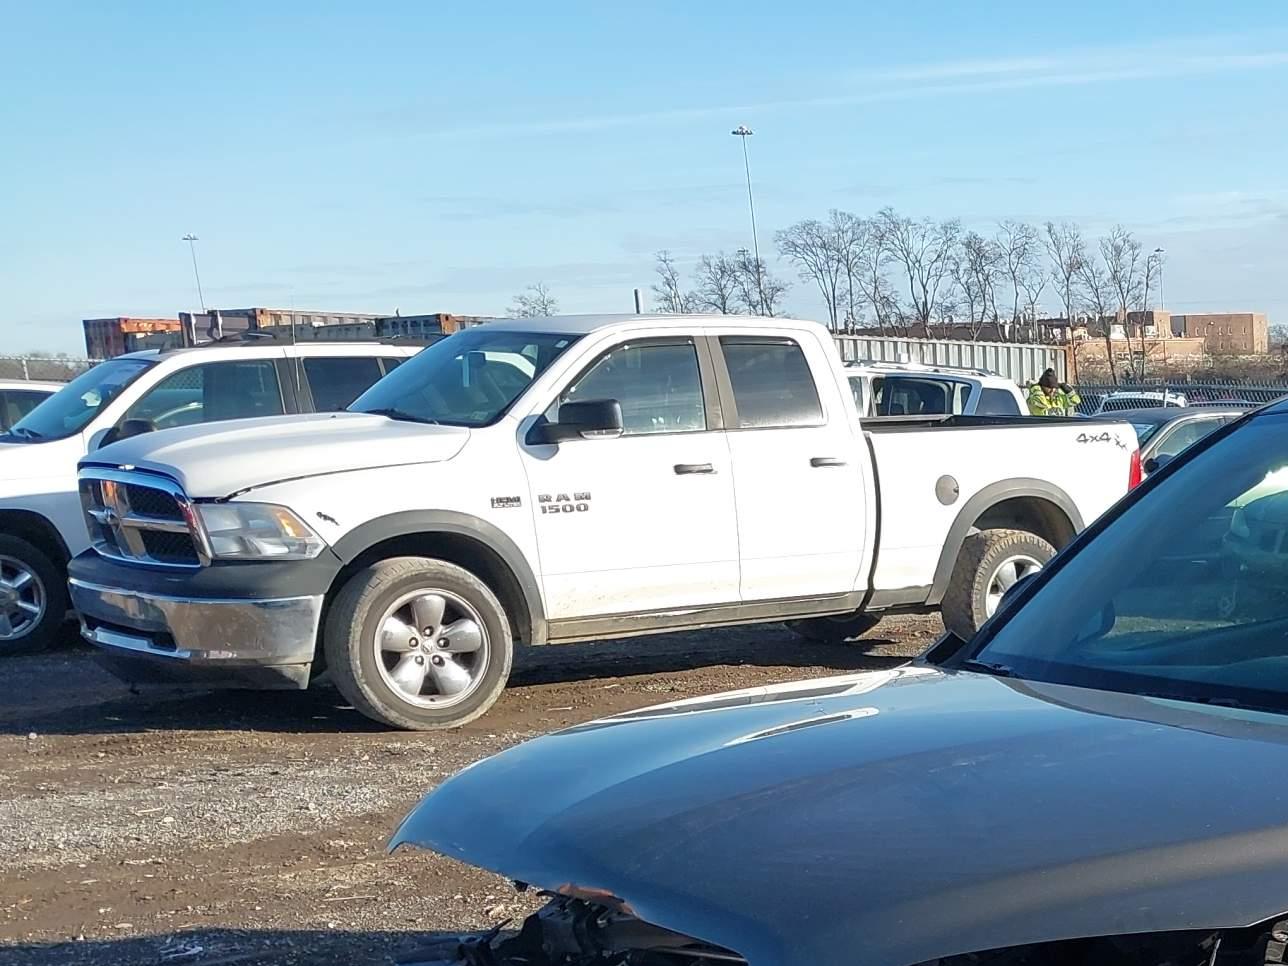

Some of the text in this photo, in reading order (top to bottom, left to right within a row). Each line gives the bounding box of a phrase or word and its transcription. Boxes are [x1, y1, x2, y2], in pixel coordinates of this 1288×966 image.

[1076, 432, 1111, 443] 4x4
[537, 492, 592, 503] RAM
[540, 503, 589, 514] 1500
